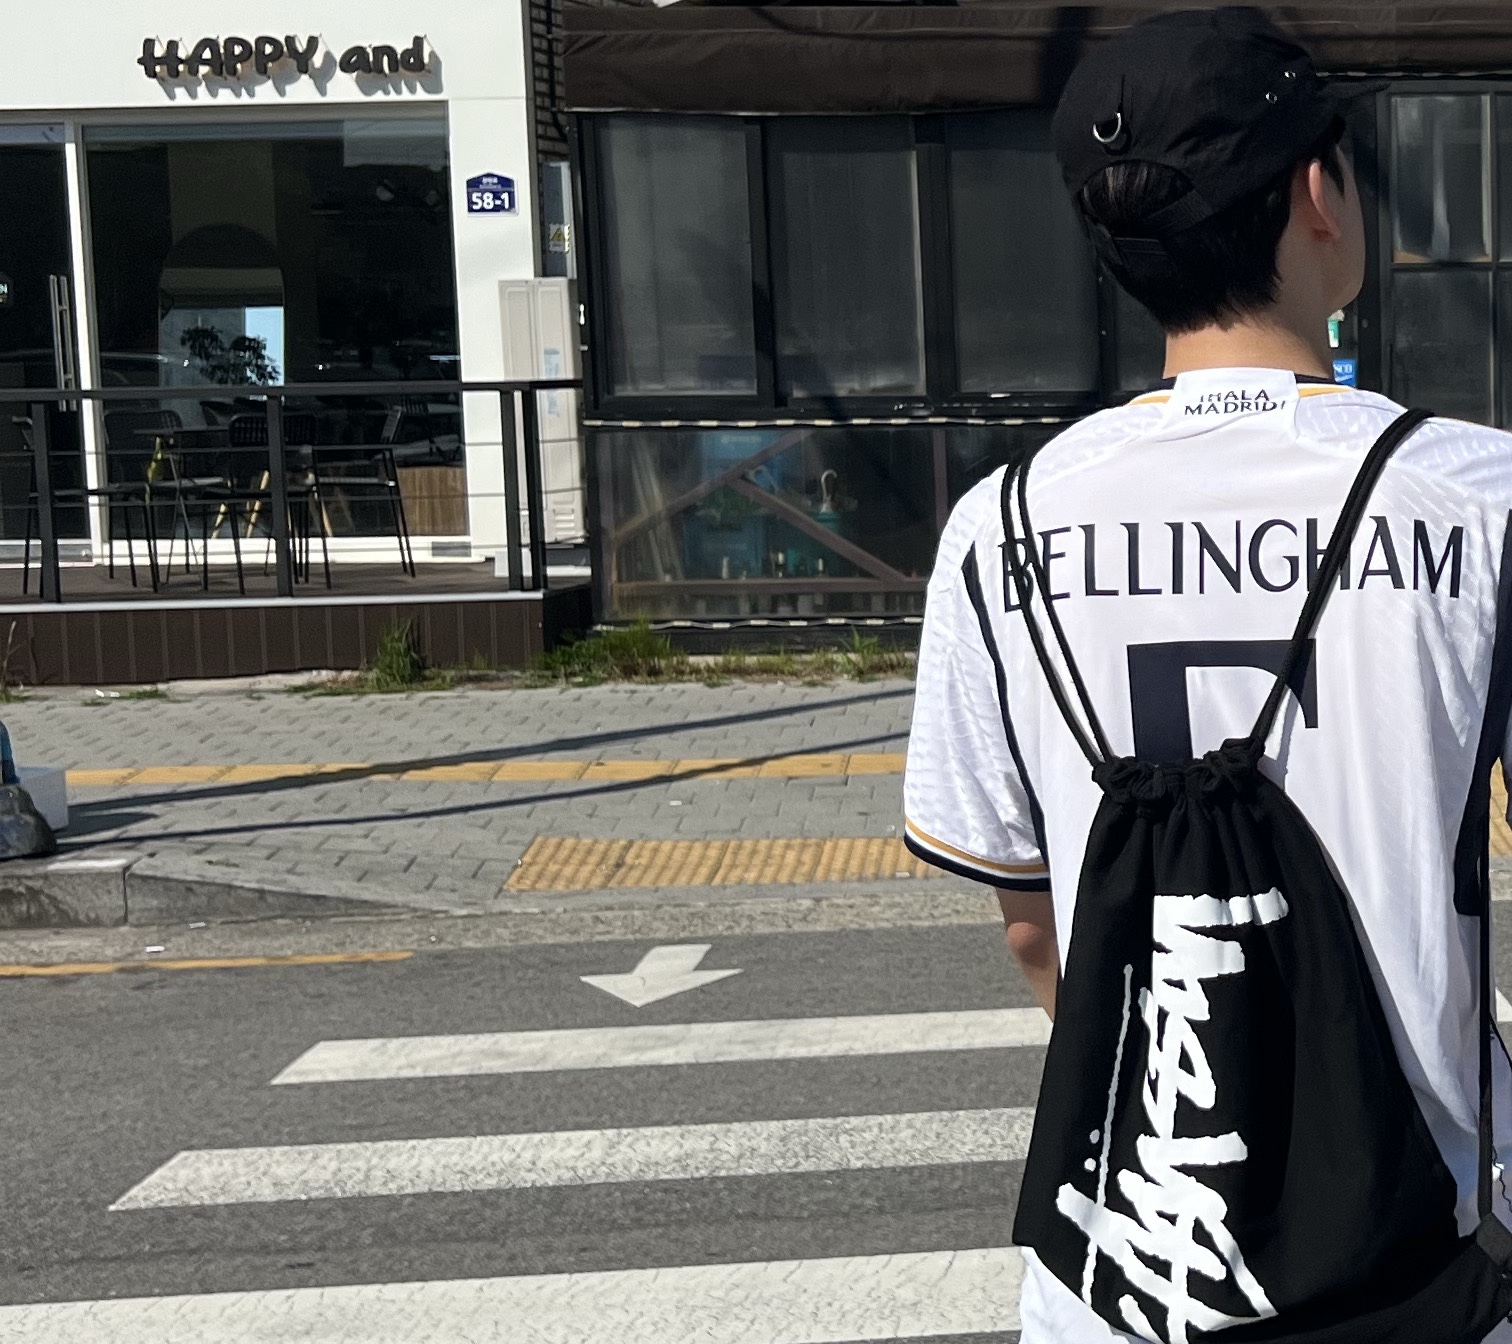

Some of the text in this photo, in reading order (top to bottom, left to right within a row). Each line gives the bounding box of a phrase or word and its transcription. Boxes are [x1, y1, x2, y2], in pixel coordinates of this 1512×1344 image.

[137, 34, 426, 79] HAPPY and
[472, 191, 510, 210] 58-1
